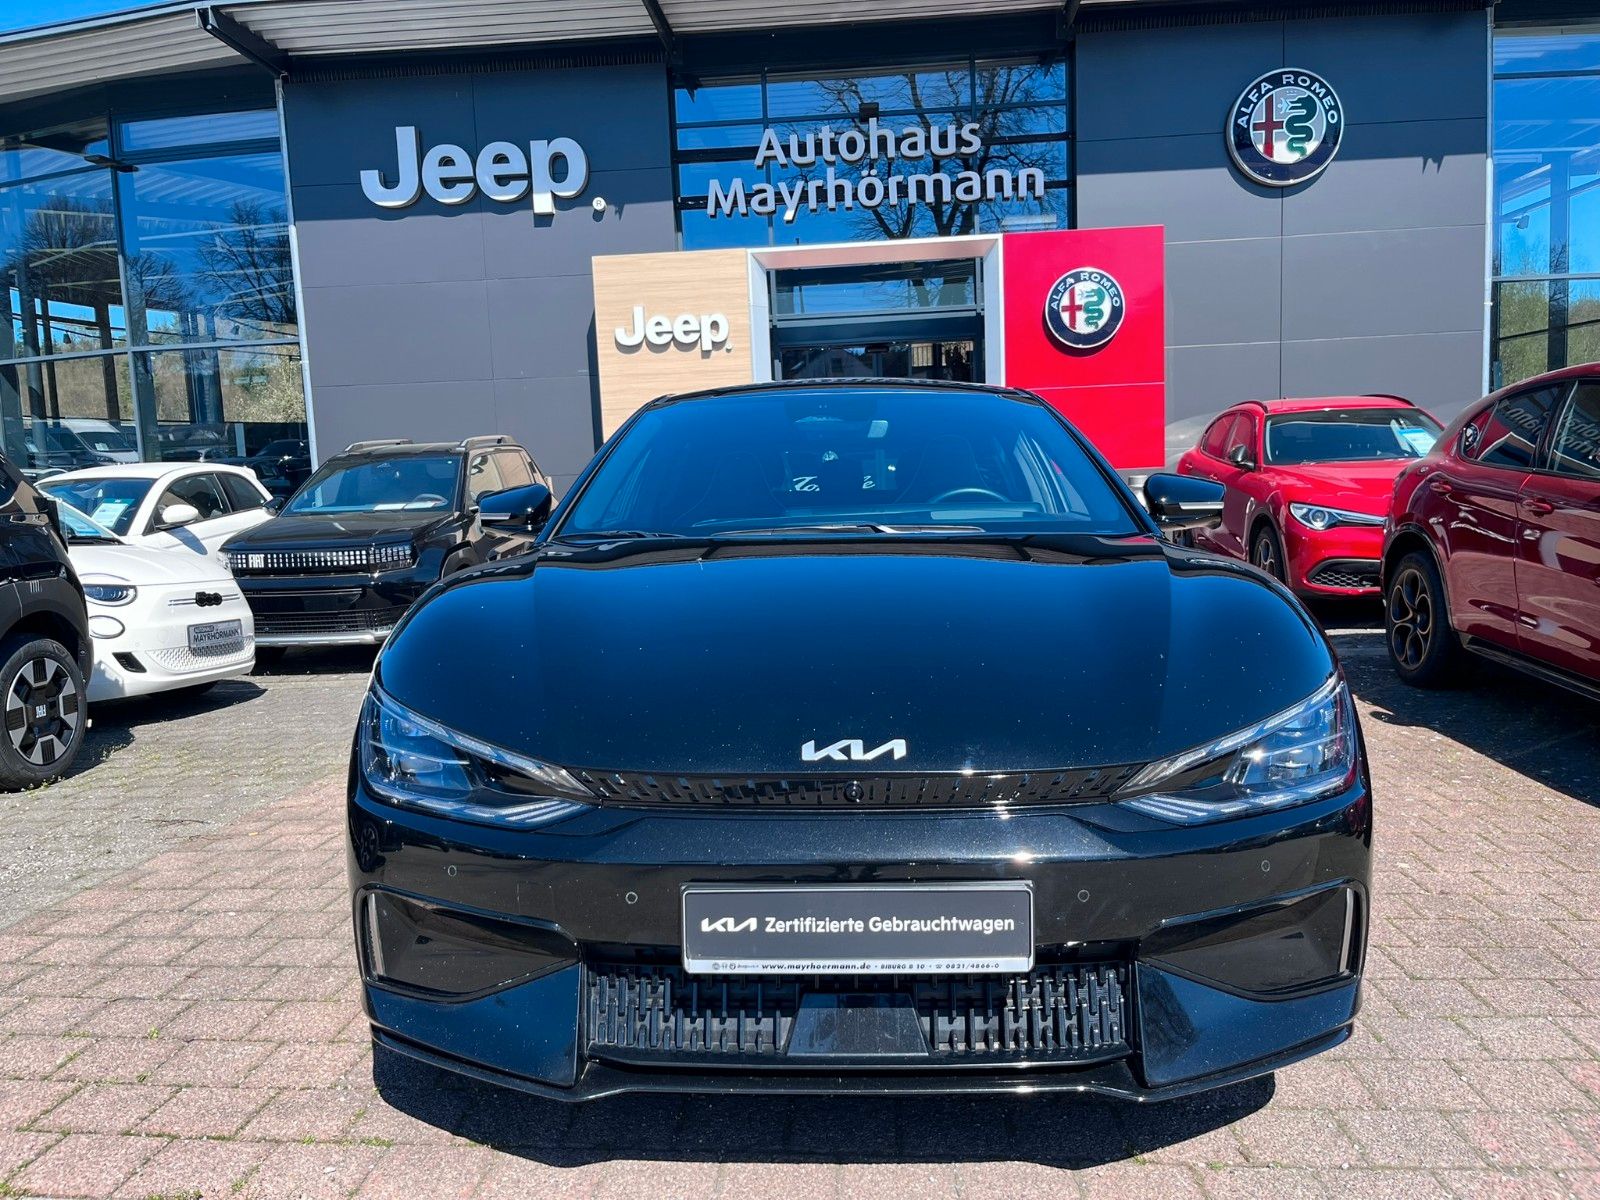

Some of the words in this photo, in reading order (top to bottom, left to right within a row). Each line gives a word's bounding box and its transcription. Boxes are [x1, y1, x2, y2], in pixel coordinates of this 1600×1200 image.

[1237, 81, 1273, 128] ALFA
[1282, 74, 1338, 124] ROMEO
[754, 117, 982, 167] Autohaus
[360, 125, 588, 215] Jeep
[706, 167, 1045, 222] Mayrhörmann
[1050, 277, 1075, 310] ALFA
[1080, 272, 1120, 307] ROMEO
[614, 304, 729, 351] Jeep
[248, 553, 265, 568] FIAT
[801, 739, 907, 761] KIA
[701, 917, 758, 932] KIA
[765, 916, 864, 933] Zertifizierte
[868, 916, 1015, 935] Gebrauchtwagen
[761, 961, 871, 971] www.mayrhoermann.de
